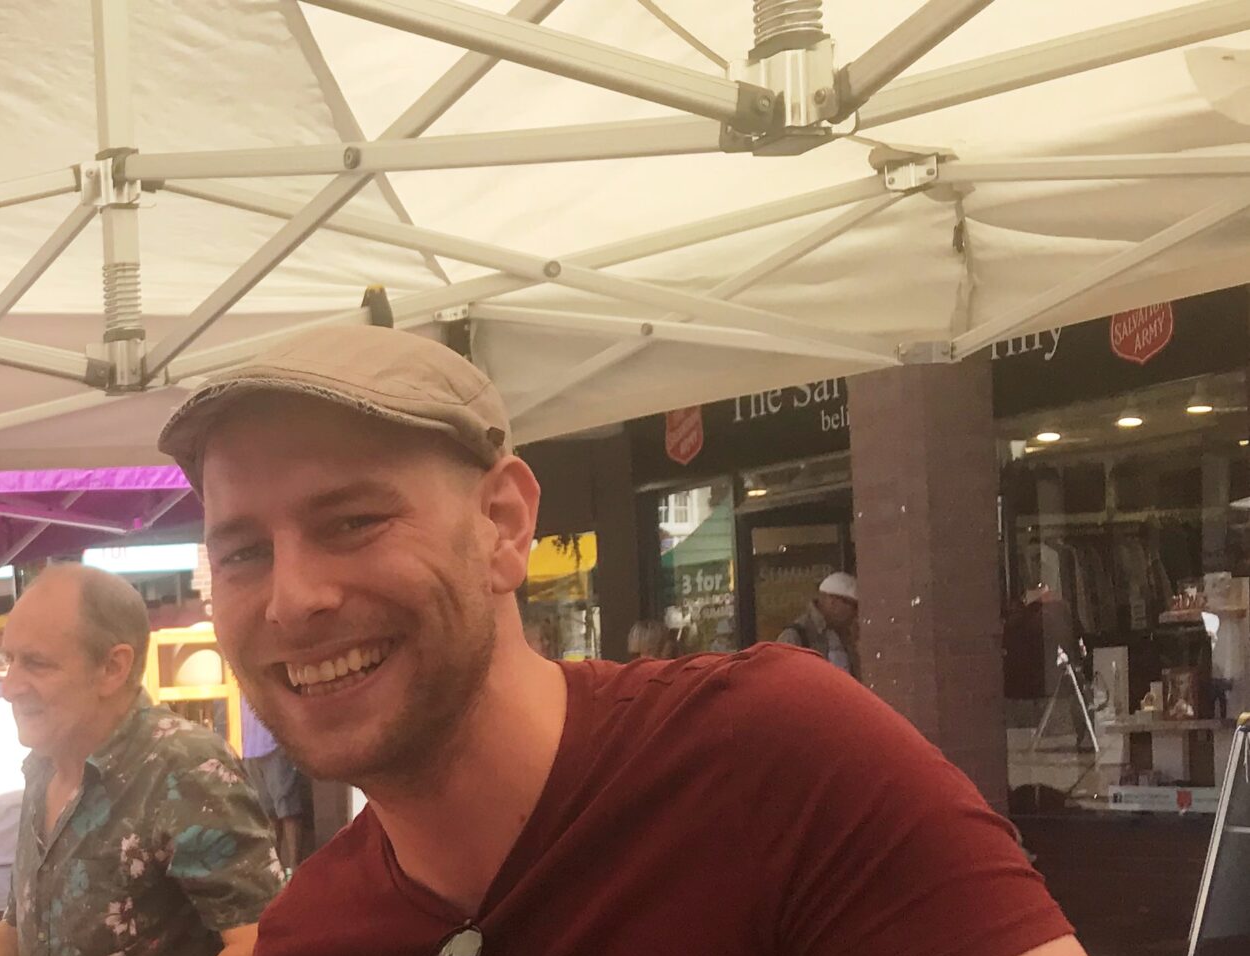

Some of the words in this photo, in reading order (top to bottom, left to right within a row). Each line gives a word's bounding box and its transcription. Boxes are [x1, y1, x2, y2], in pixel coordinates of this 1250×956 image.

[1134, 311, 1165, 354] ARMY
[821, 404, 850, 432] beli
[682, 574, 692, 595] 3
[696, 569, 723, 592] for
